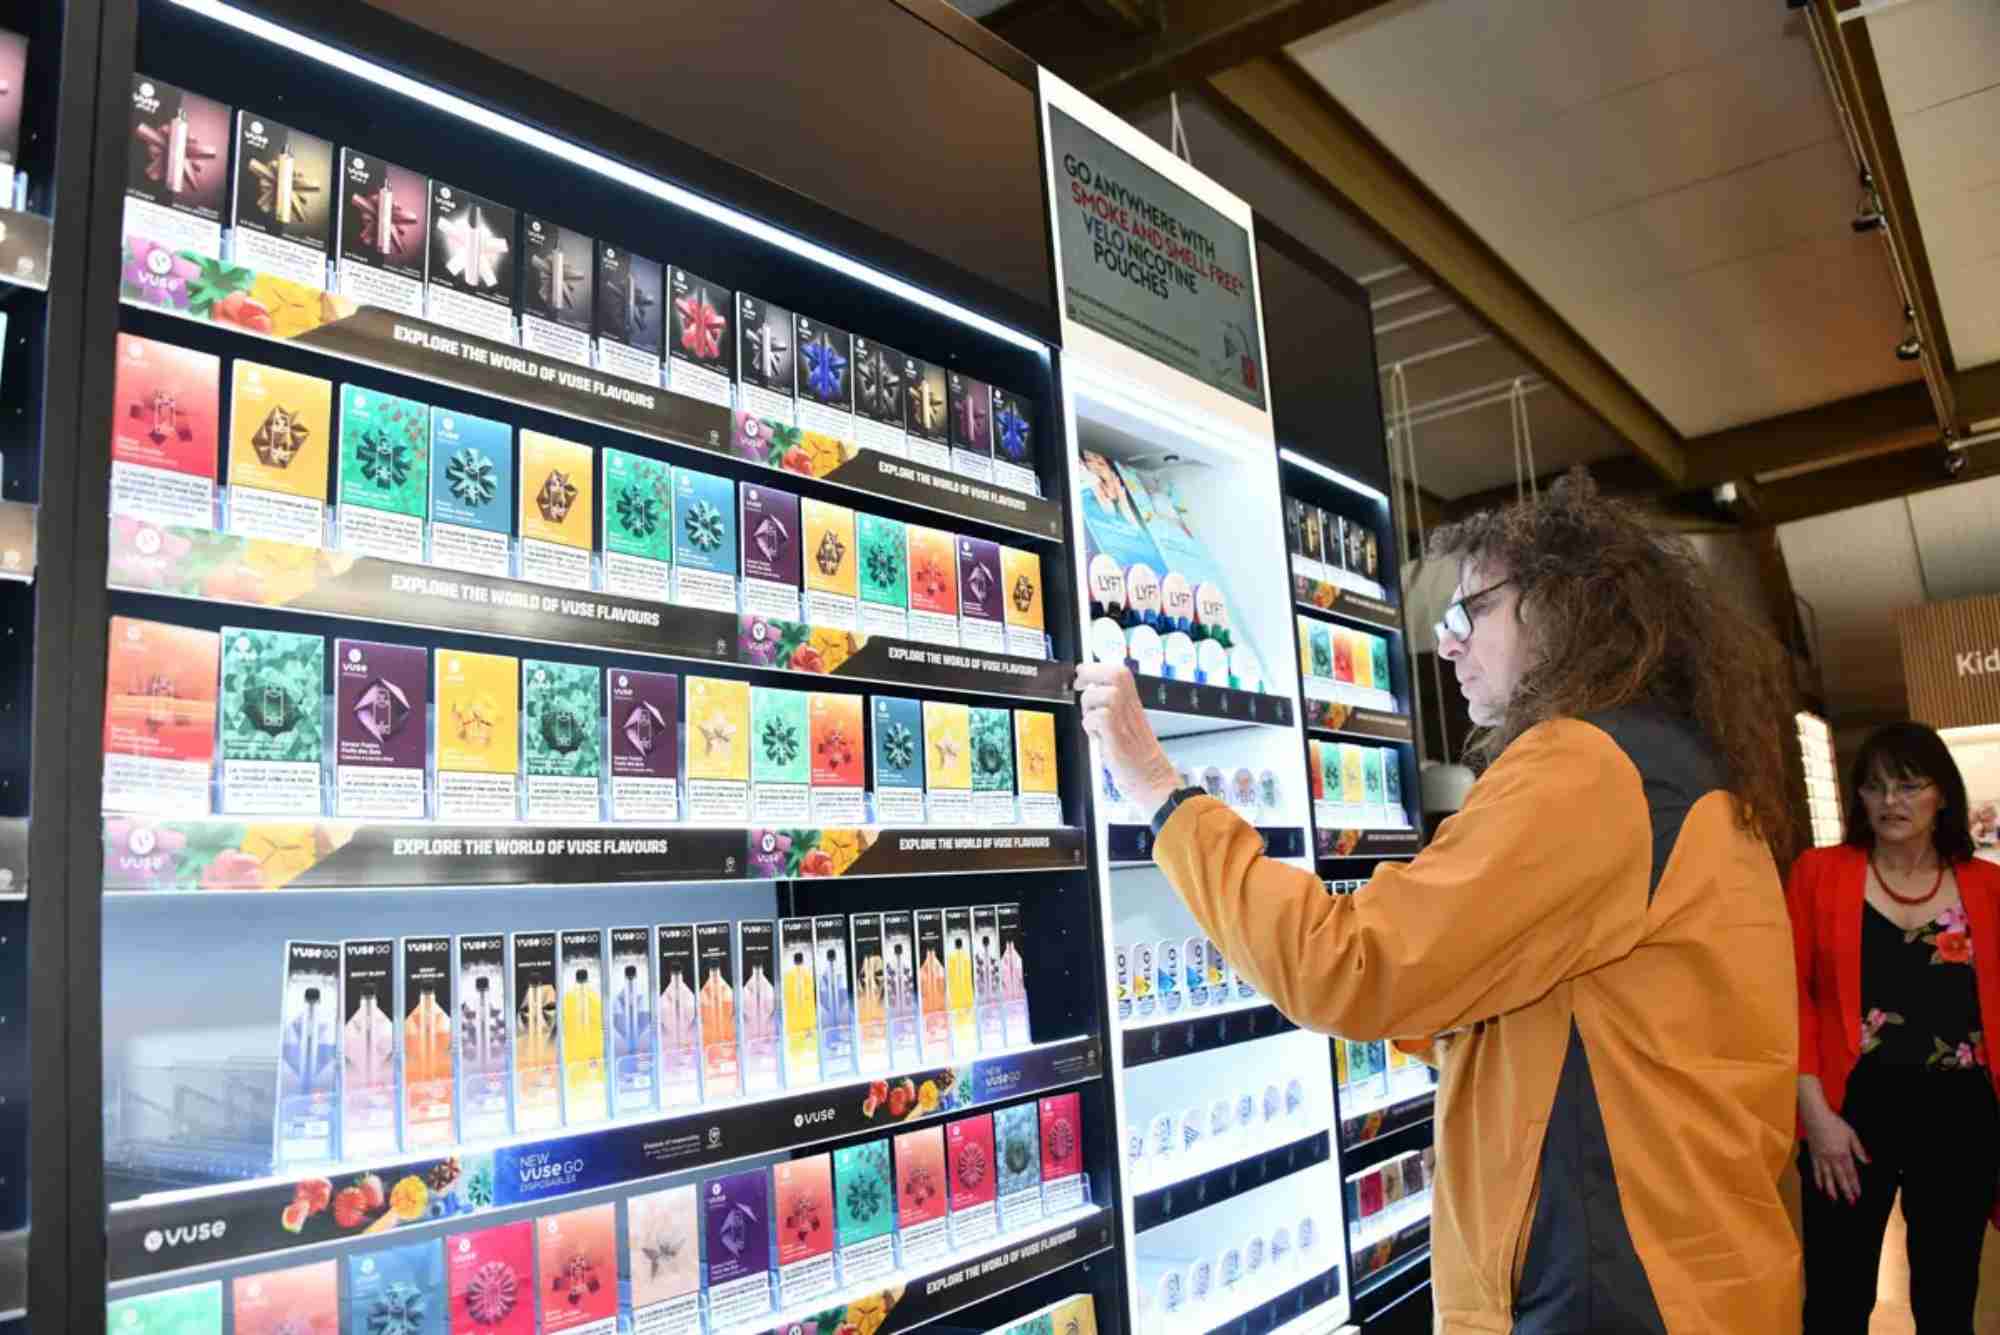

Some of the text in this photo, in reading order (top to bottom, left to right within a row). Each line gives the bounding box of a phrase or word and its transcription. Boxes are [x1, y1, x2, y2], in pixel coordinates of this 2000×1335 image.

[1064, 154, 1216, 260] GO ANYWHERE WITH
[1071, 181, 1129, 232] SMOKE
[1131, 222, 1163, 250] AND
[1163, 236, 1209, 278] SMELL
[1081, 210, 1198, 295] VELO NICOTINE
[1093, 242, 1169, 299] POUCHES
[393, 324, 655, 410] EXPLORE THE WORLD OF VUSE FLAVOURS
[879, 460, 915, 480] EXPLORE
[916, 468, 933, 486] THE
[934, 472, 958, 493] WORLD
[391, 573, 660, 628] EXPLORE THE WORLD OF VUSE FLAVOURS
[888, 646, 926, 664] EXPLORE
[928, 650, 943, 666] THE
[943, 653, 970, 668] WORLD
[972, 655, 981, 669] OF
[392, 838, 668, 856] EXPLORE THE WORLD OF VUSE FLAVOURS
[899, 837, 937, 850] EXPLORE
[937, 837, 953, 849] THE
[954, 837, 982, 849] WORLD
[983, 837, 993, 849] OF
[805, 1107, 836, 1125] vuse
[519, 1151, 550, 1168] NEW
[520, 1158, 584, 1182] vuse GO
[165, 1219, 226, 1247] vuse
[926, 1270, 964, 1295] EXPLORE
[965, 1263, 980, 1281] THE
[981, 1253, 1009, 1274] WORLD
[1009, 1249, 1020, 1263] OF
